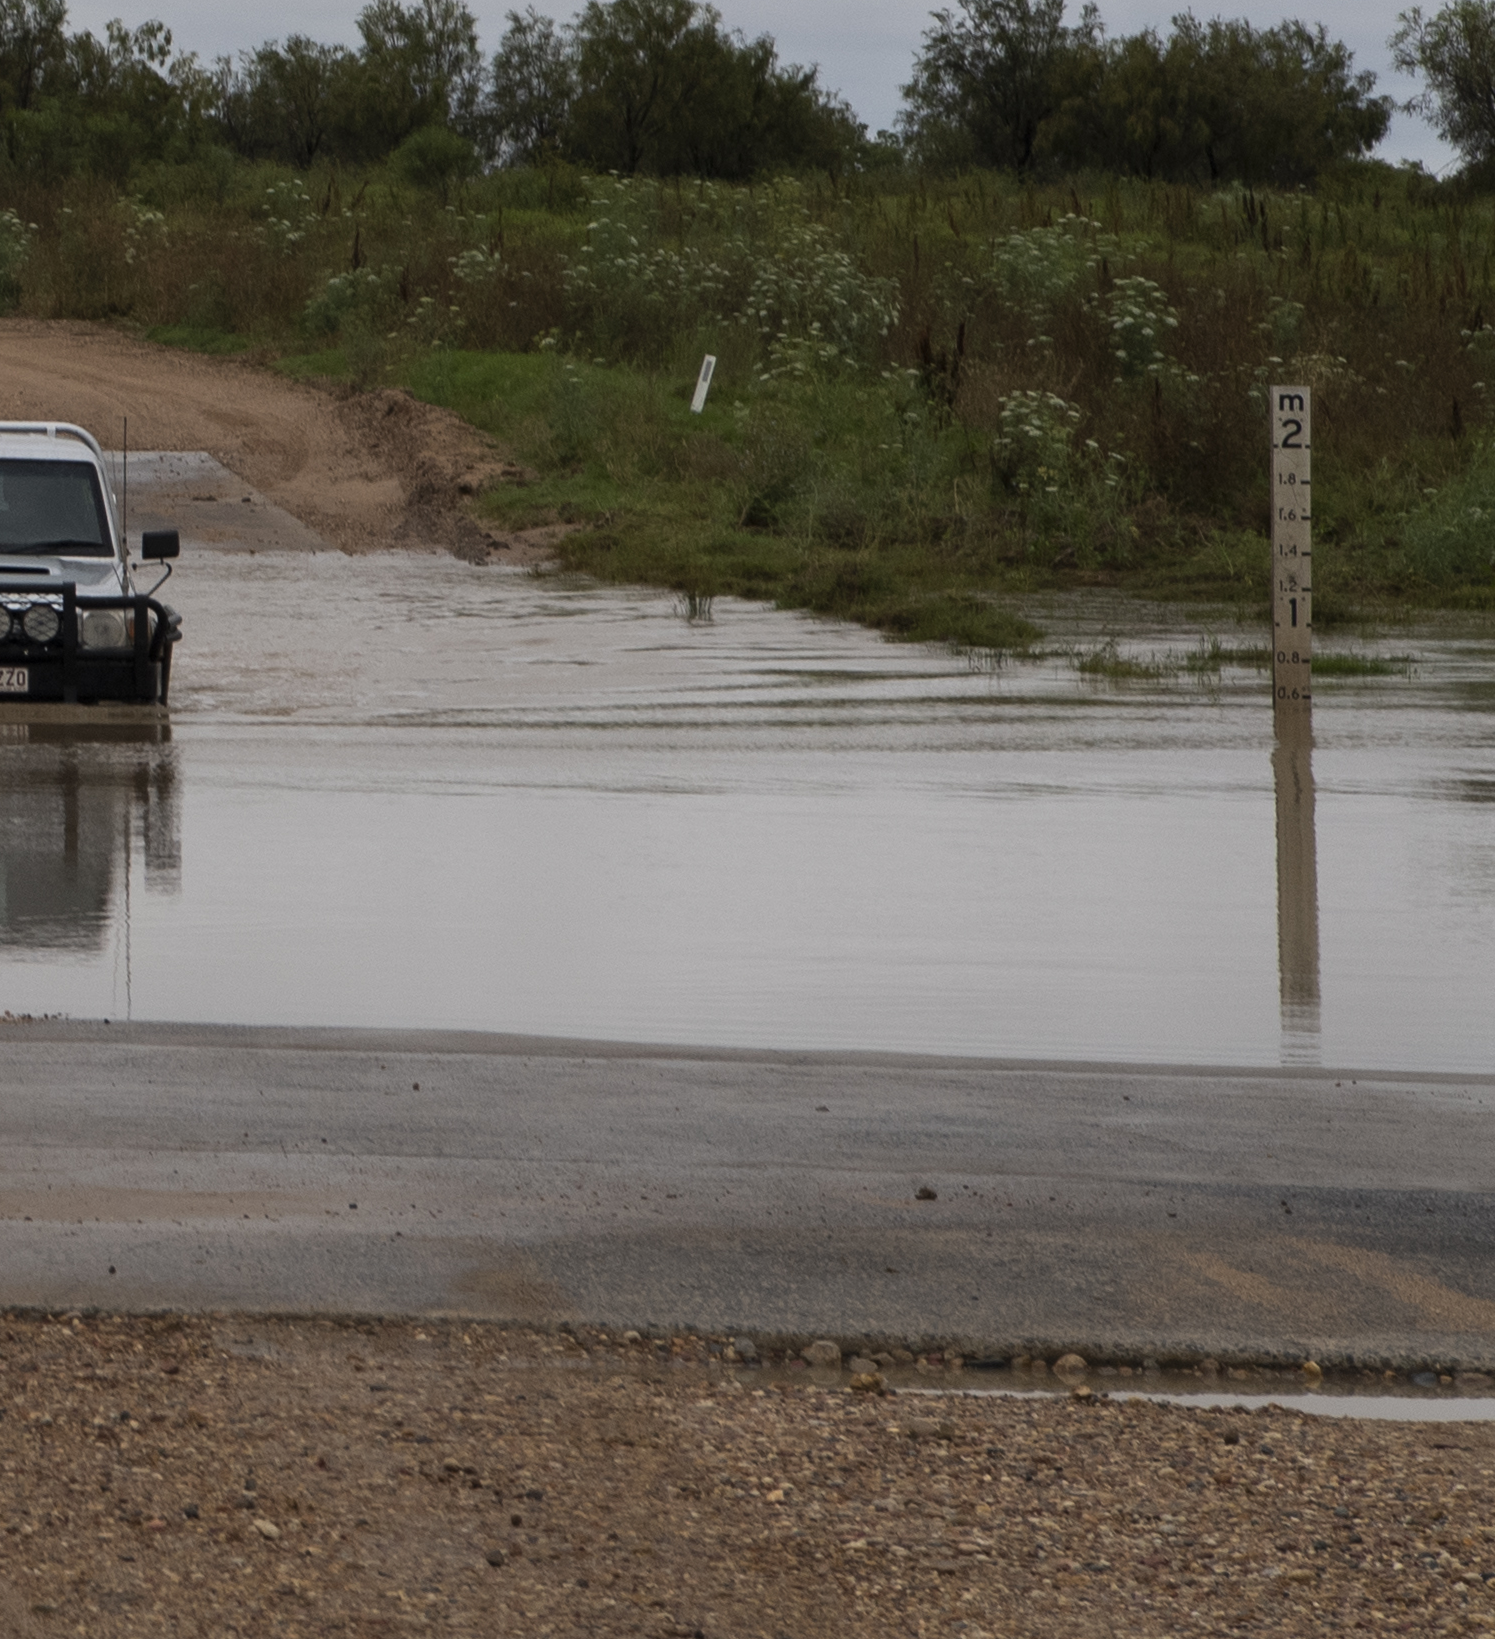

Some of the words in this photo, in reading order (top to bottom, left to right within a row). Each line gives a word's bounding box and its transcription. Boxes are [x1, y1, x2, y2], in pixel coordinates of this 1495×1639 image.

[1279, 394, 1304, 411] m
[1282, 419, 1302, 448] 2
[1279, 473, 1296, 485] 1.8
[1279, 508, 1296, 520] 1.6
[1279, 544, 1297, 556] 1.4
[1279, 580, 1297, 592] 1.2
[1289, 598, 1297, 627] 1
[1277, 651, 1300, 664] 0.8
[1277, 686, 1300, 700] 0.6
